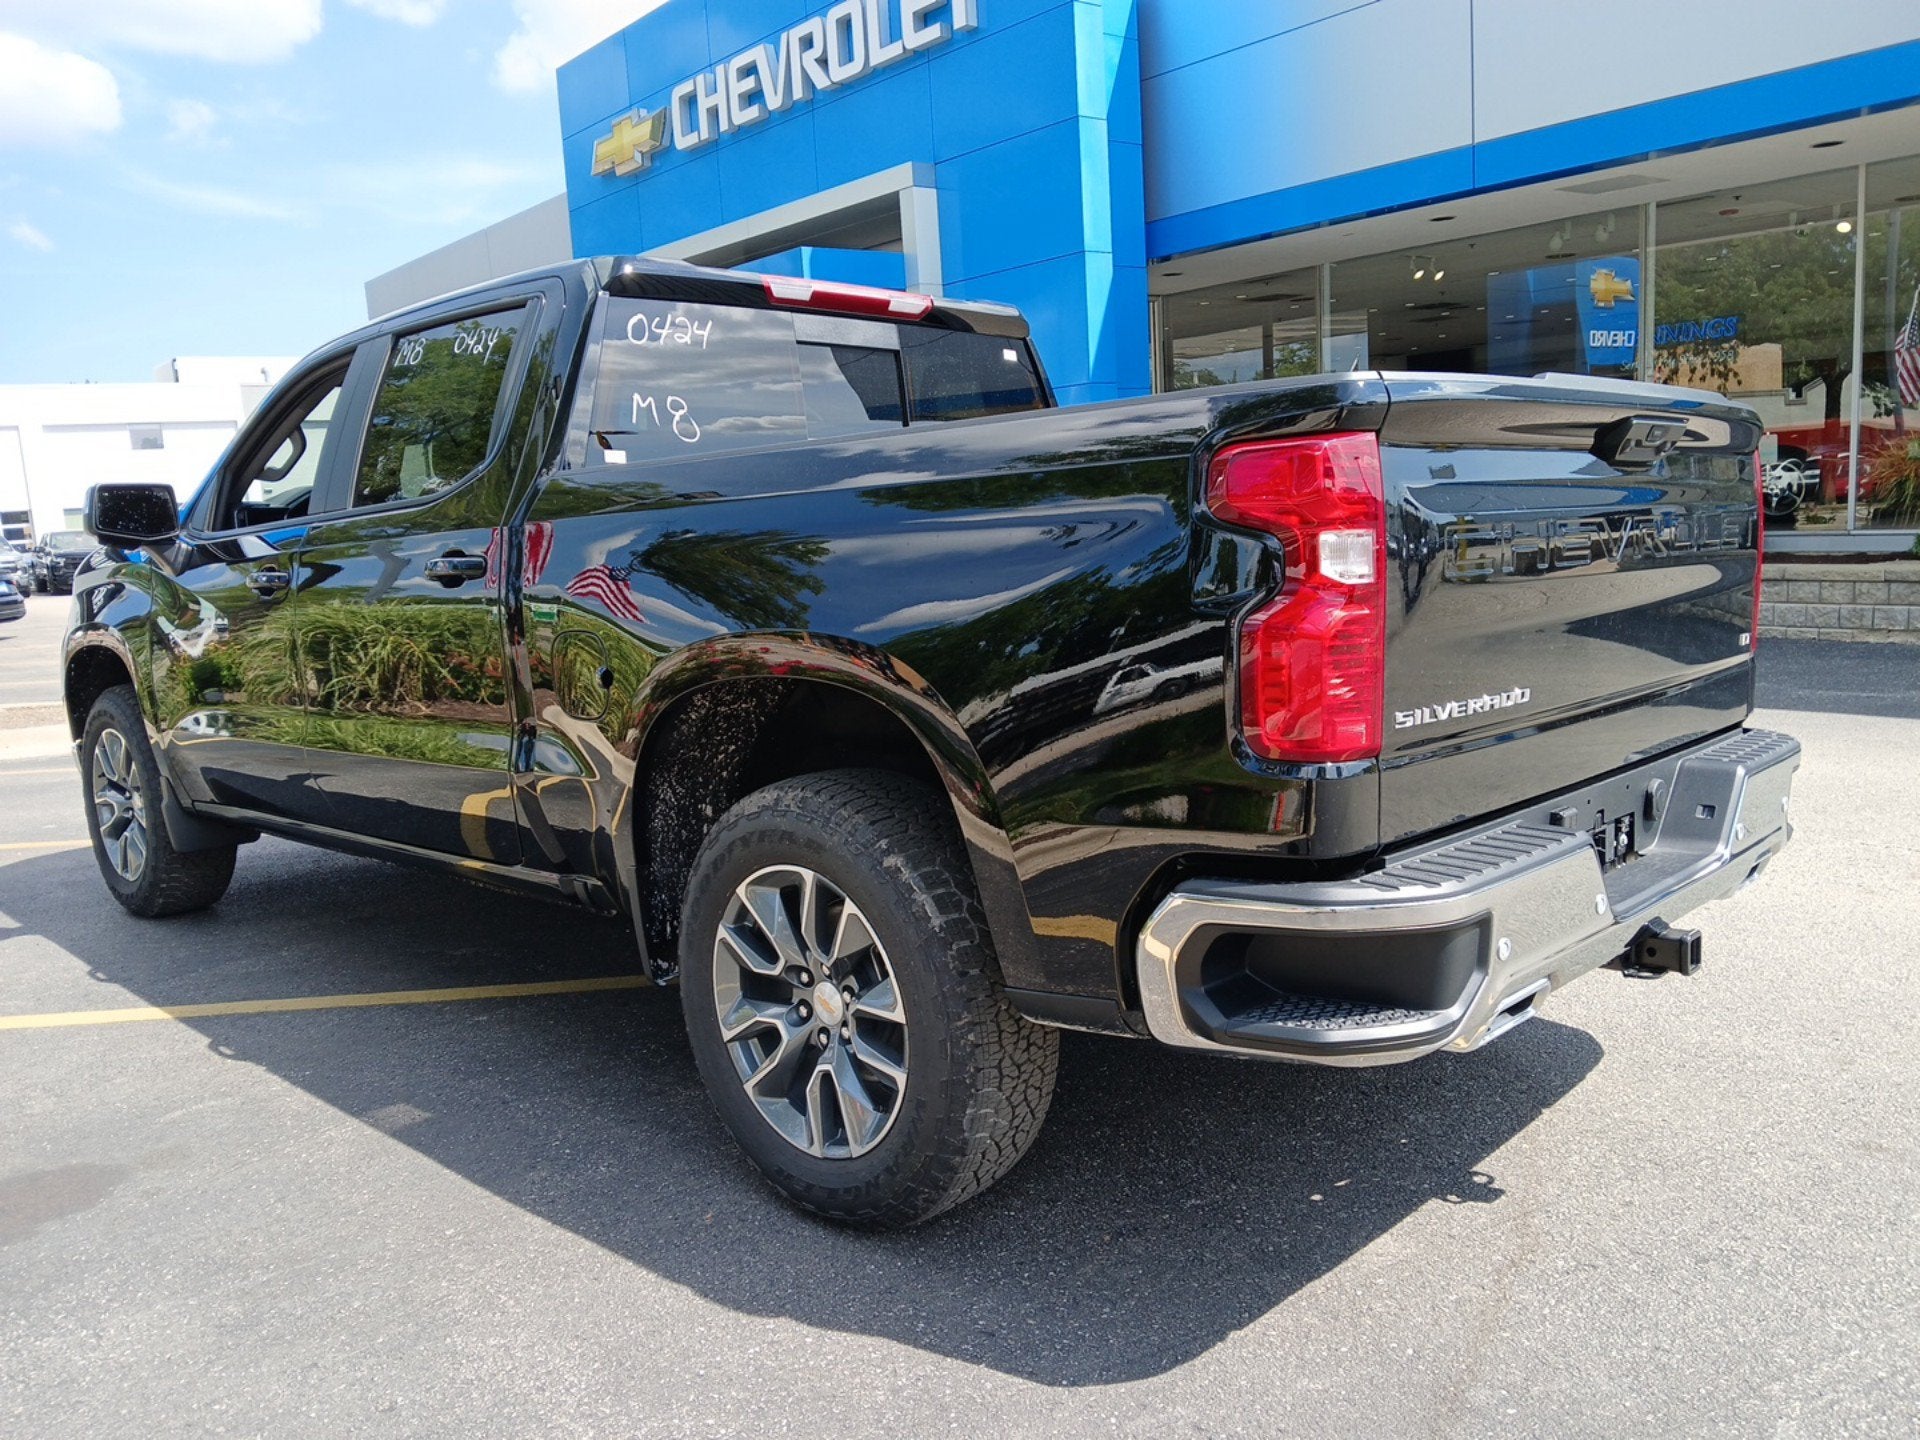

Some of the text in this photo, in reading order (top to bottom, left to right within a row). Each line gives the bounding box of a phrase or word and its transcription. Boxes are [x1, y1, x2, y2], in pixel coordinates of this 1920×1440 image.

[394, 327, 500, 367] M8 0424
[627, 312, 712, 349] 0424
[1395, 686, 1531, 729] SILVERADO
